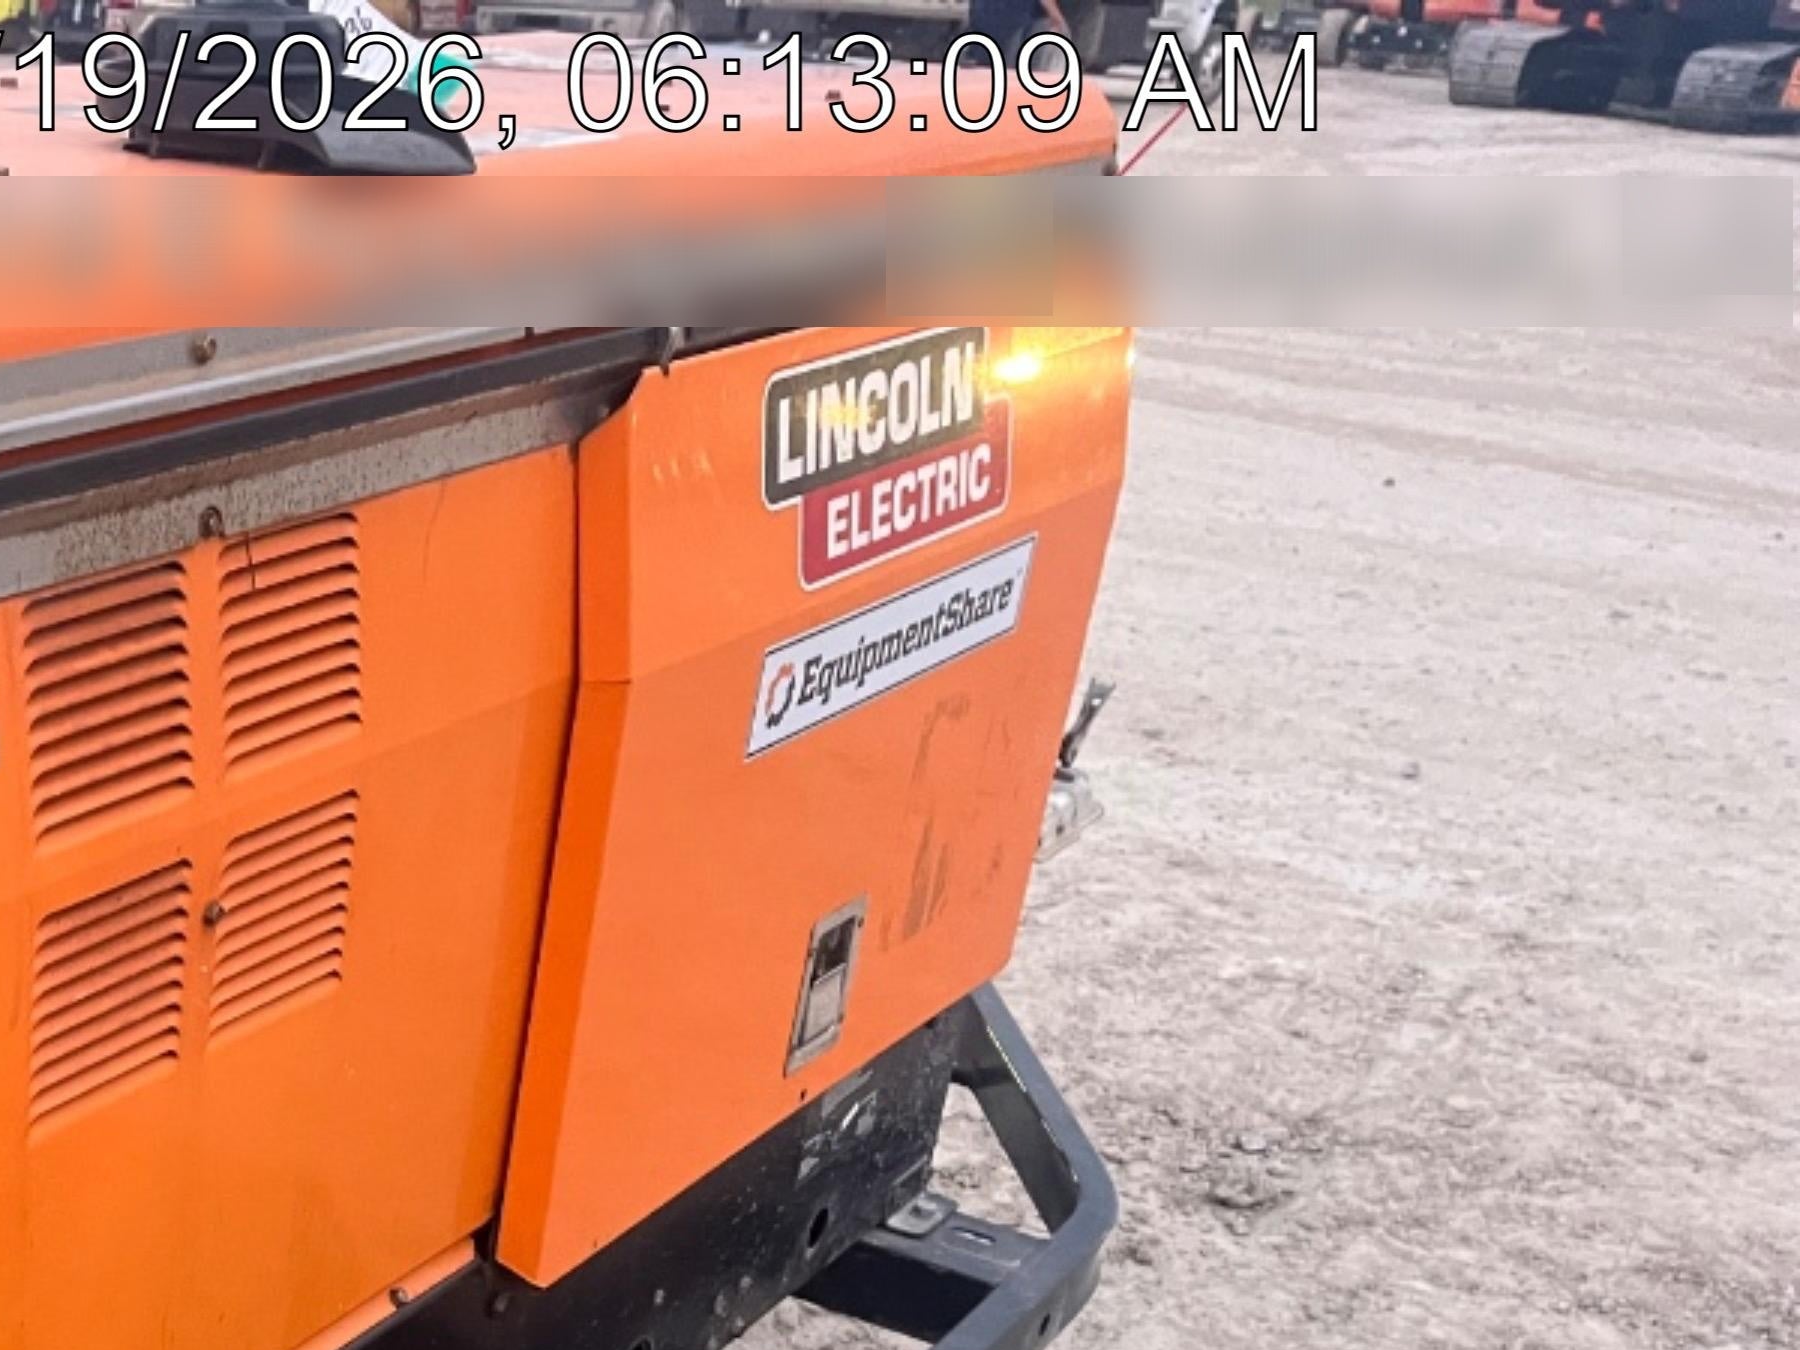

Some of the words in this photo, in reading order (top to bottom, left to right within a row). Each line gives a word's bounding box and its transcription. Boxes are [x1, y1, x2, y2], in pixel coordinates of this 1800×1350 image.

[777, 341, 977, 485] LINCOLN
[826, 443, 992, 561] ELECTRIC
[796, 577, 1015, 706] EquipmentShare
